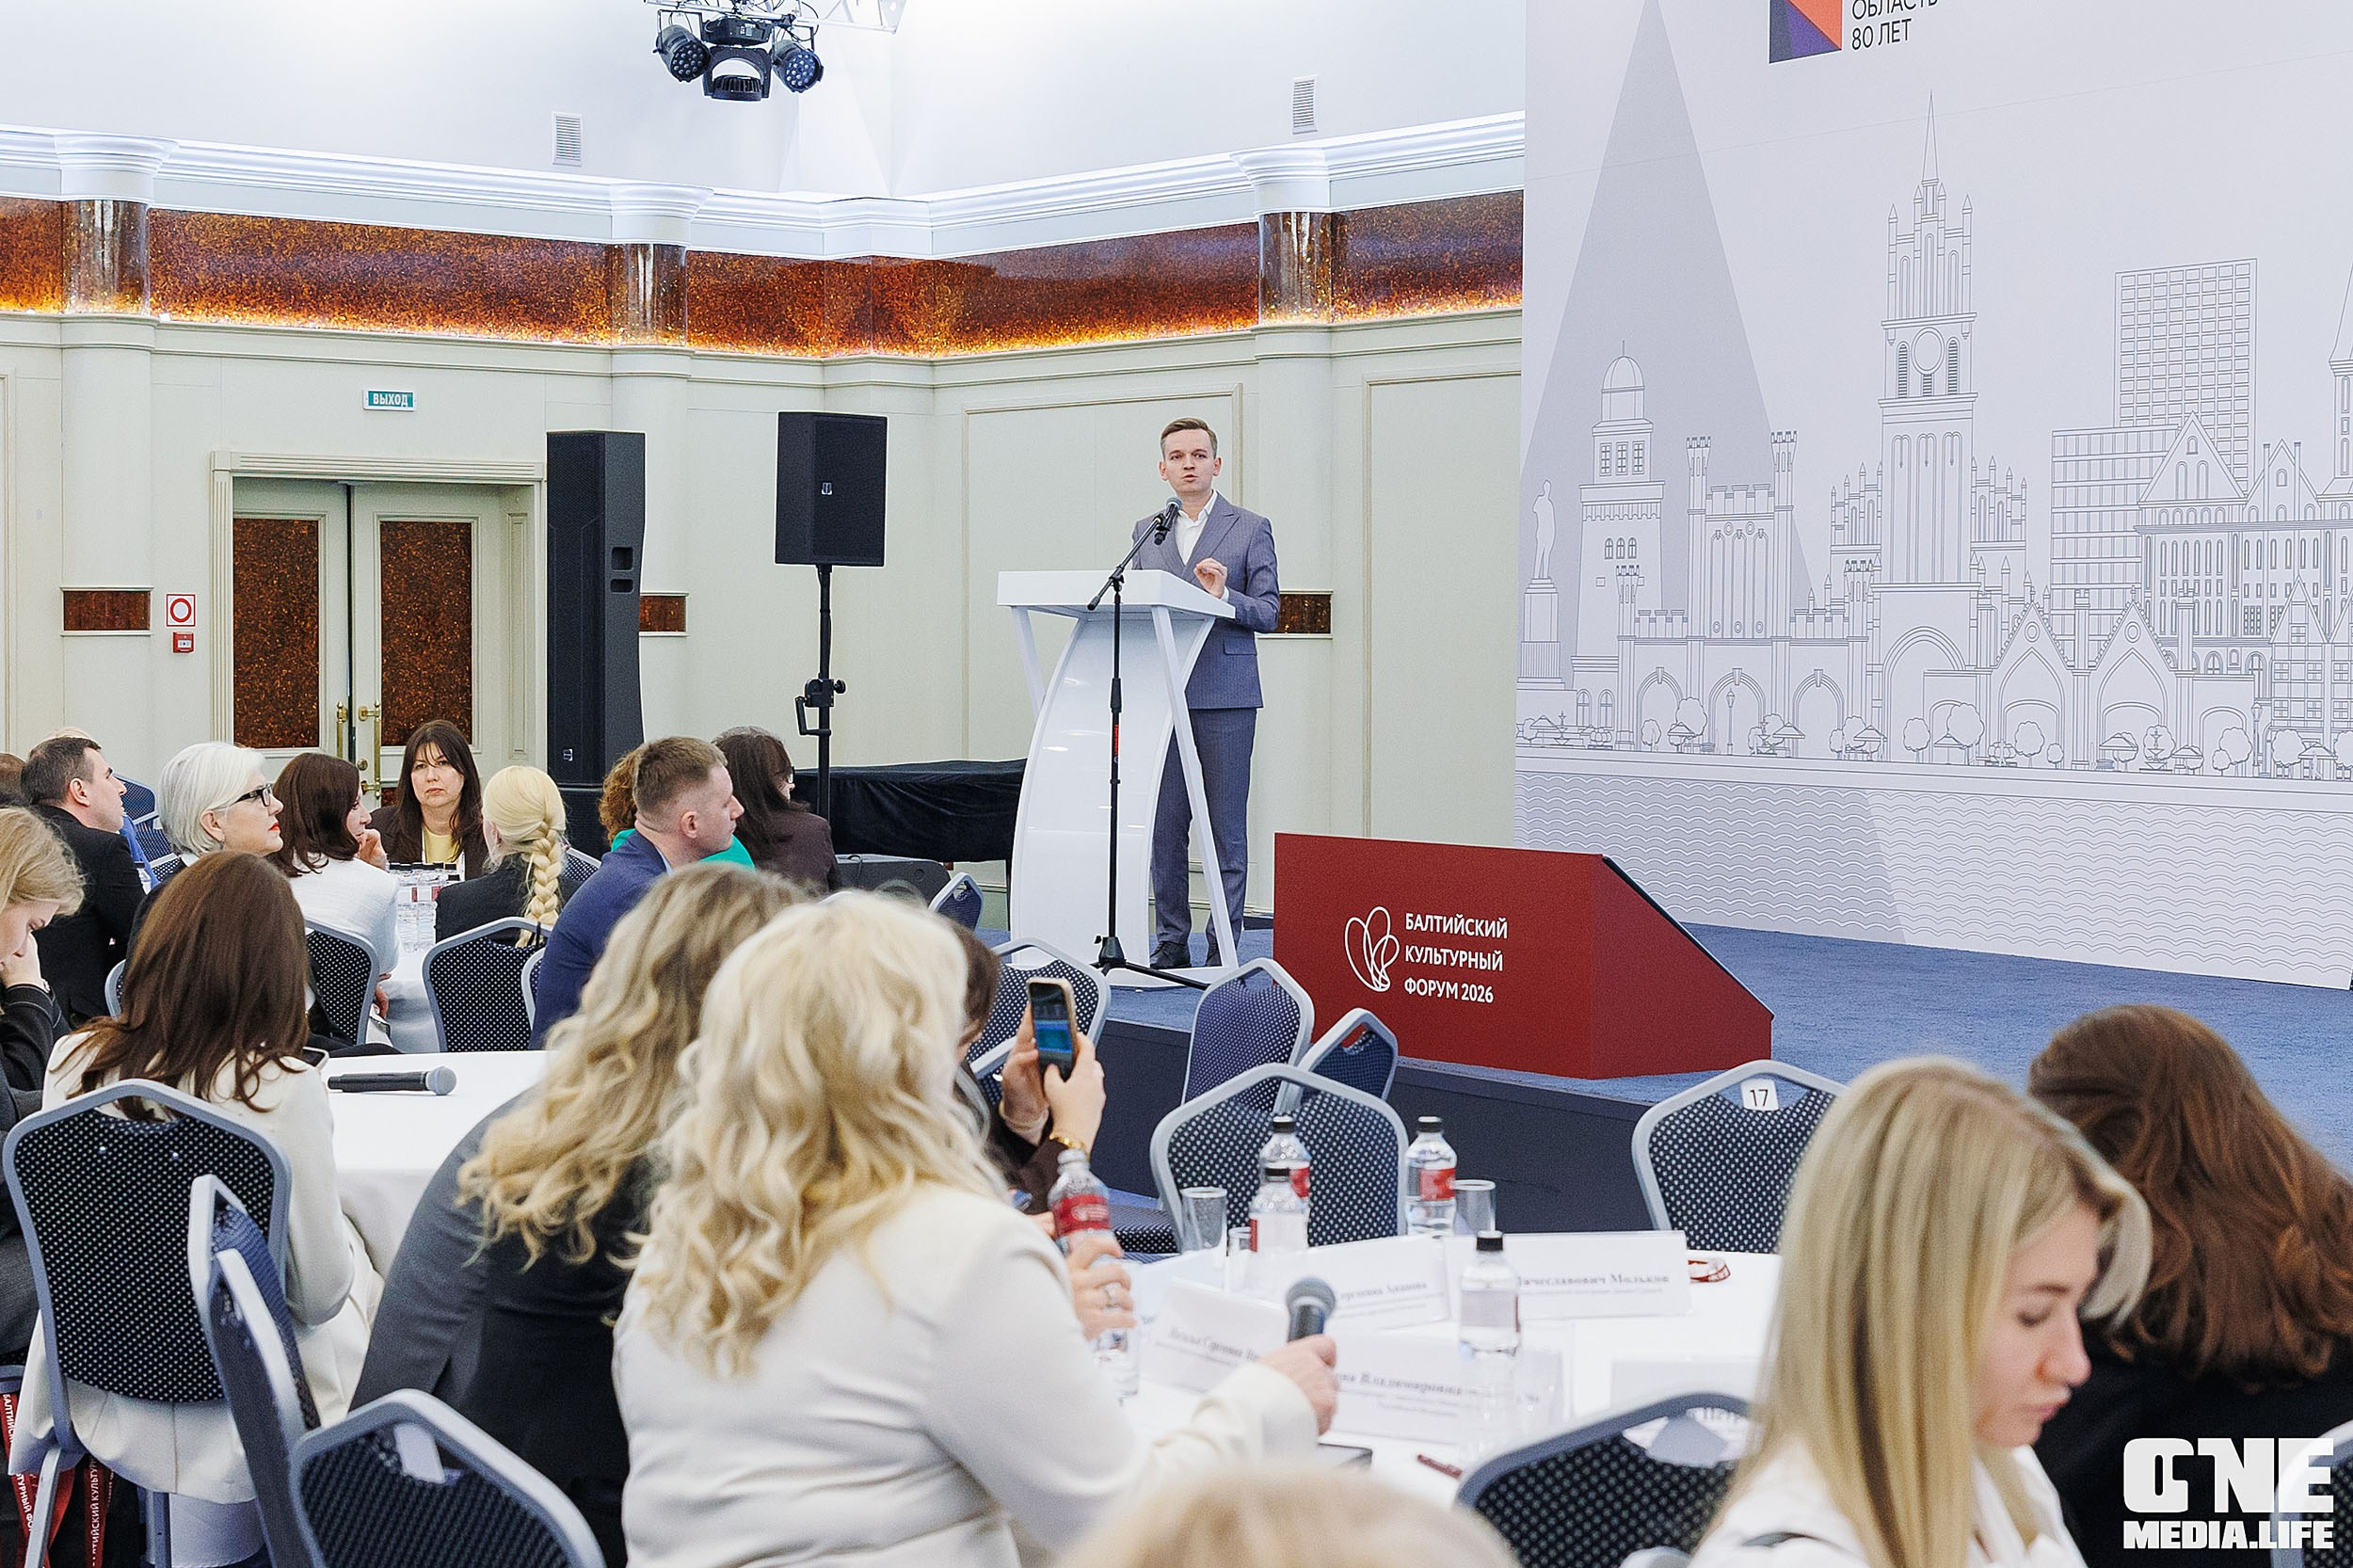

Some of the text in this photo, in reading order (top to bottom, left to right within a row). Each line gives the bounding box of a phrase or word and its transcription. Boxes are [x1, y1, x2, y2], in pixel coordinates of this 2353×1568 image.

[1852, 0, 1938, 20] ОБЛА
[1851, 18, 1913, 51] 80 ЛЕТ
[373, 392, 408, 408] ВЫХОД
[1405, 912, 1508, 939] БАЛТИЙСКИЙ
[1405, 944, 1504, 971] КУЛЬТУРНЫЙ
[1403, 977, 1495, 1003] ФОРУМ 2026
[1749, 1089, 1769, 1107] 17
